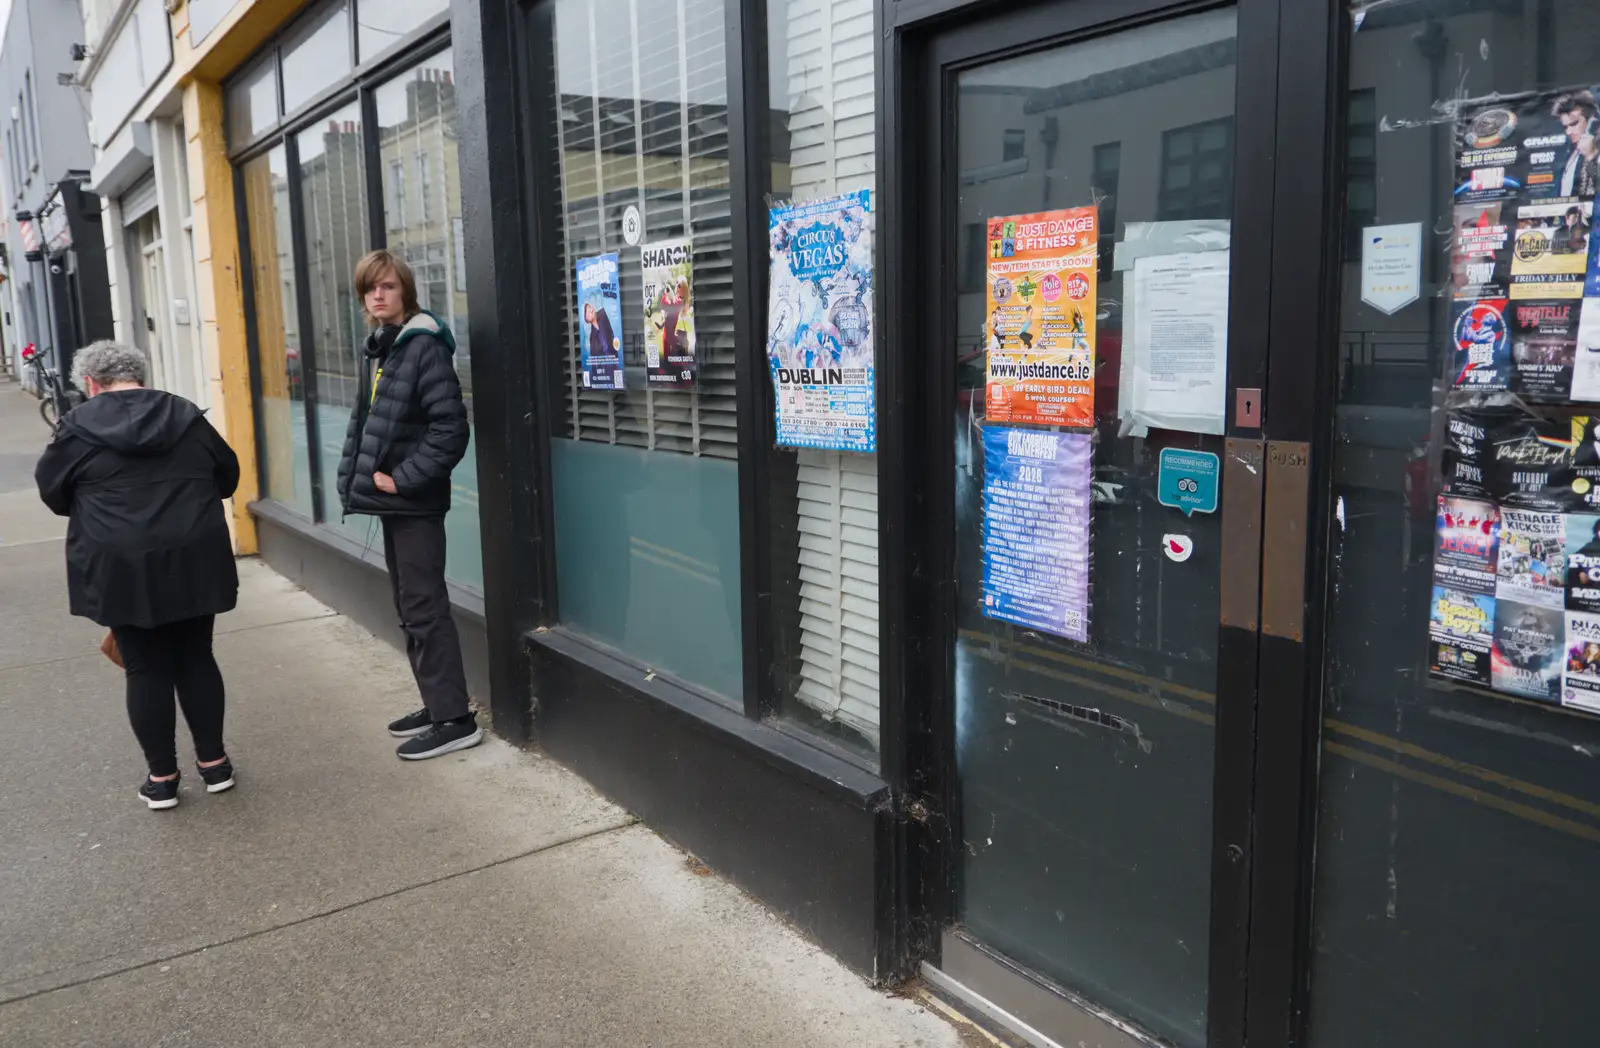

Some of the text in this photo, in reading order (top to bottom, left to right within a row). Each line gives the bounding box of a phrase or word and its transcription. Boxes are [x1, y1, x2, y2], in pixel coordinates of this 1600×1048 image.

[1016, 216, 1094, 238] JUST DANCE
[798, 230, 836, 248] CIRCUS
[1016, 235, 1076, 250] & FITNESS
[642, 244, 692, 268] SHARON
[792, 244, 844, 270] VEGAS
[992, 257, 1091, 272] NEW TERM STARTS SOON!
[1044, 279, 1060, 289] Pole
[1555, 275, 1578, 283] JULY
[644, 285, 656, 298] OCT
[646, 299, 653, 318] 3
[778, 368, 843, 384] DUBLIN
[990, 361, 1090, 380] www.justdance.ie
[1025, 384, 1046, 393] EARLY
[1047, 385, 1065, 394] BIRD
[1269, 451, 1307, 467] PUSH
[1496, 445, 1567, 464] Pink Floyd
[1164, 456, 1214, 469] RECOMMENDED
[1456, 462, 1482, 474] FRIDAY
[1512, 472, 1548, 484] SATURDAY
[1502, 512, 1561, 524] TEENAGE
[1507, 521, 1541, 534] KICKS
[1440, 535, 1492, 557] JERSEY
[1467, 578, 1494, 587] KITCHEN
[1439, 600, 1486, 621] Beach
[1444, 614, 1480, 634] Boys
[1431, 636, 1450, 645] FRIDAY
[1460, 642, 1489, 653] OCTOBER
[1568, 678, 1592, 686] FRIDAY
